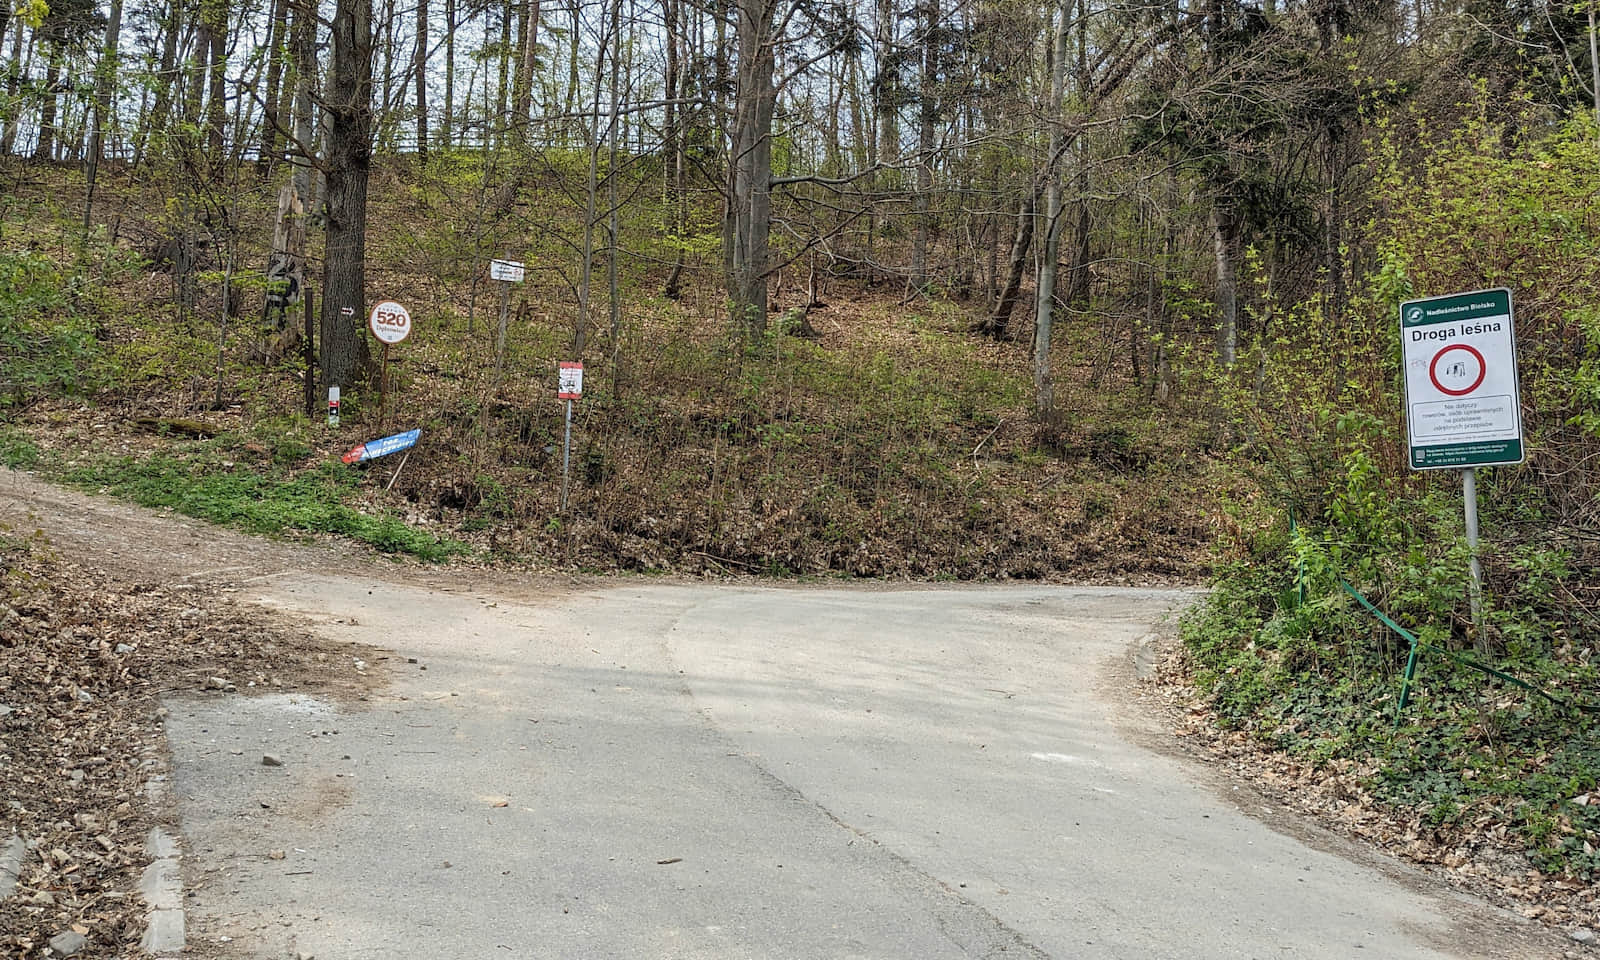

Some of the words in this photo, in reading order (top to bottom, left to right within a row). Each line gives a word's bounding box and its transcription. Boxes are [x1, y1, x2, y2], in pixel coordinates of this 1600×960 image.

[1426, 305, 1469, 316] Nadleśnictwo
[1470, 302, 1496, 311] Bielsko
[376, 311, 406, 327] 520
[1412, 327, 1457, 342] Droga
[1460, 322, 1502, 337] leśna
